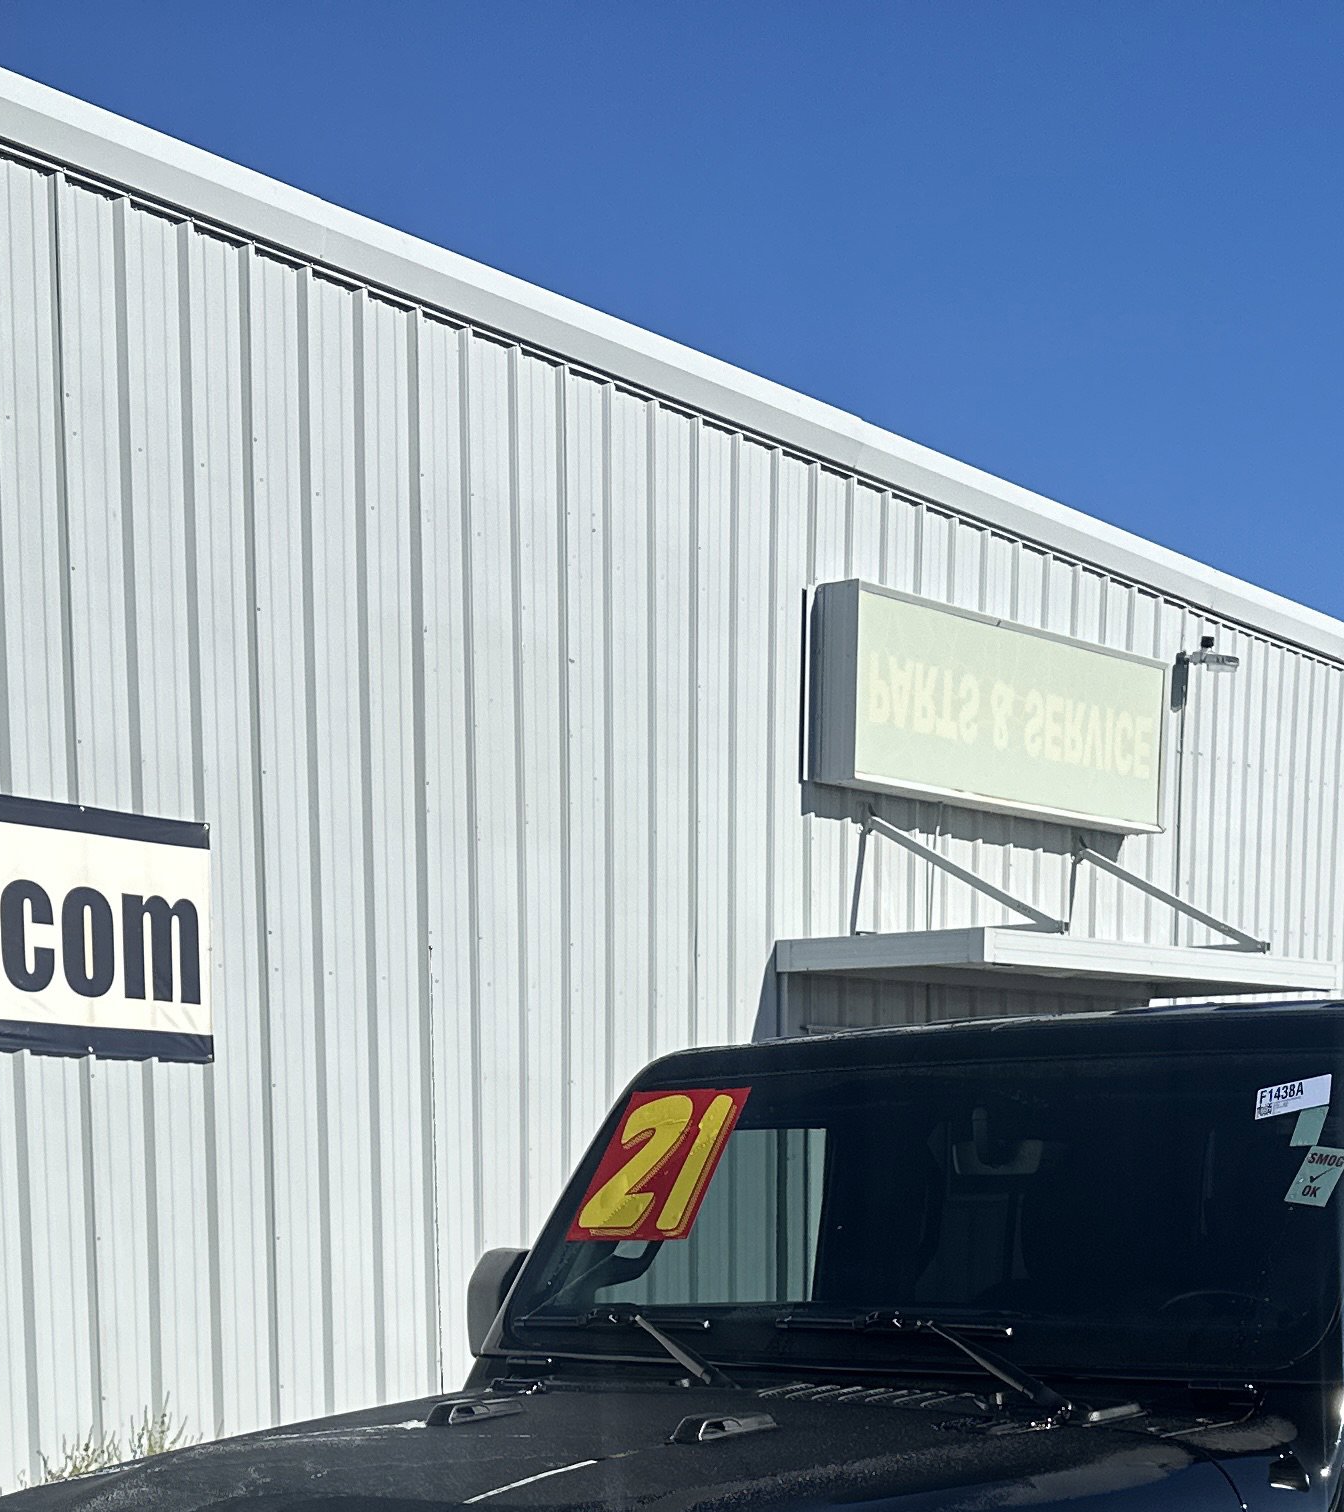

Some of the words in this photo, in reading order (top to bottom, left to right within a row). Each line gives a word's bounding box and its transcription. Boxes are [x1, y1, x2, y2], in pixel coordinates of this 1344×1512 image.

[1259, 1081, 1304, 1104] F1438A
[578, 1094, 736, 1234] 21
[1301, 1185, 1320, 1198] OK
